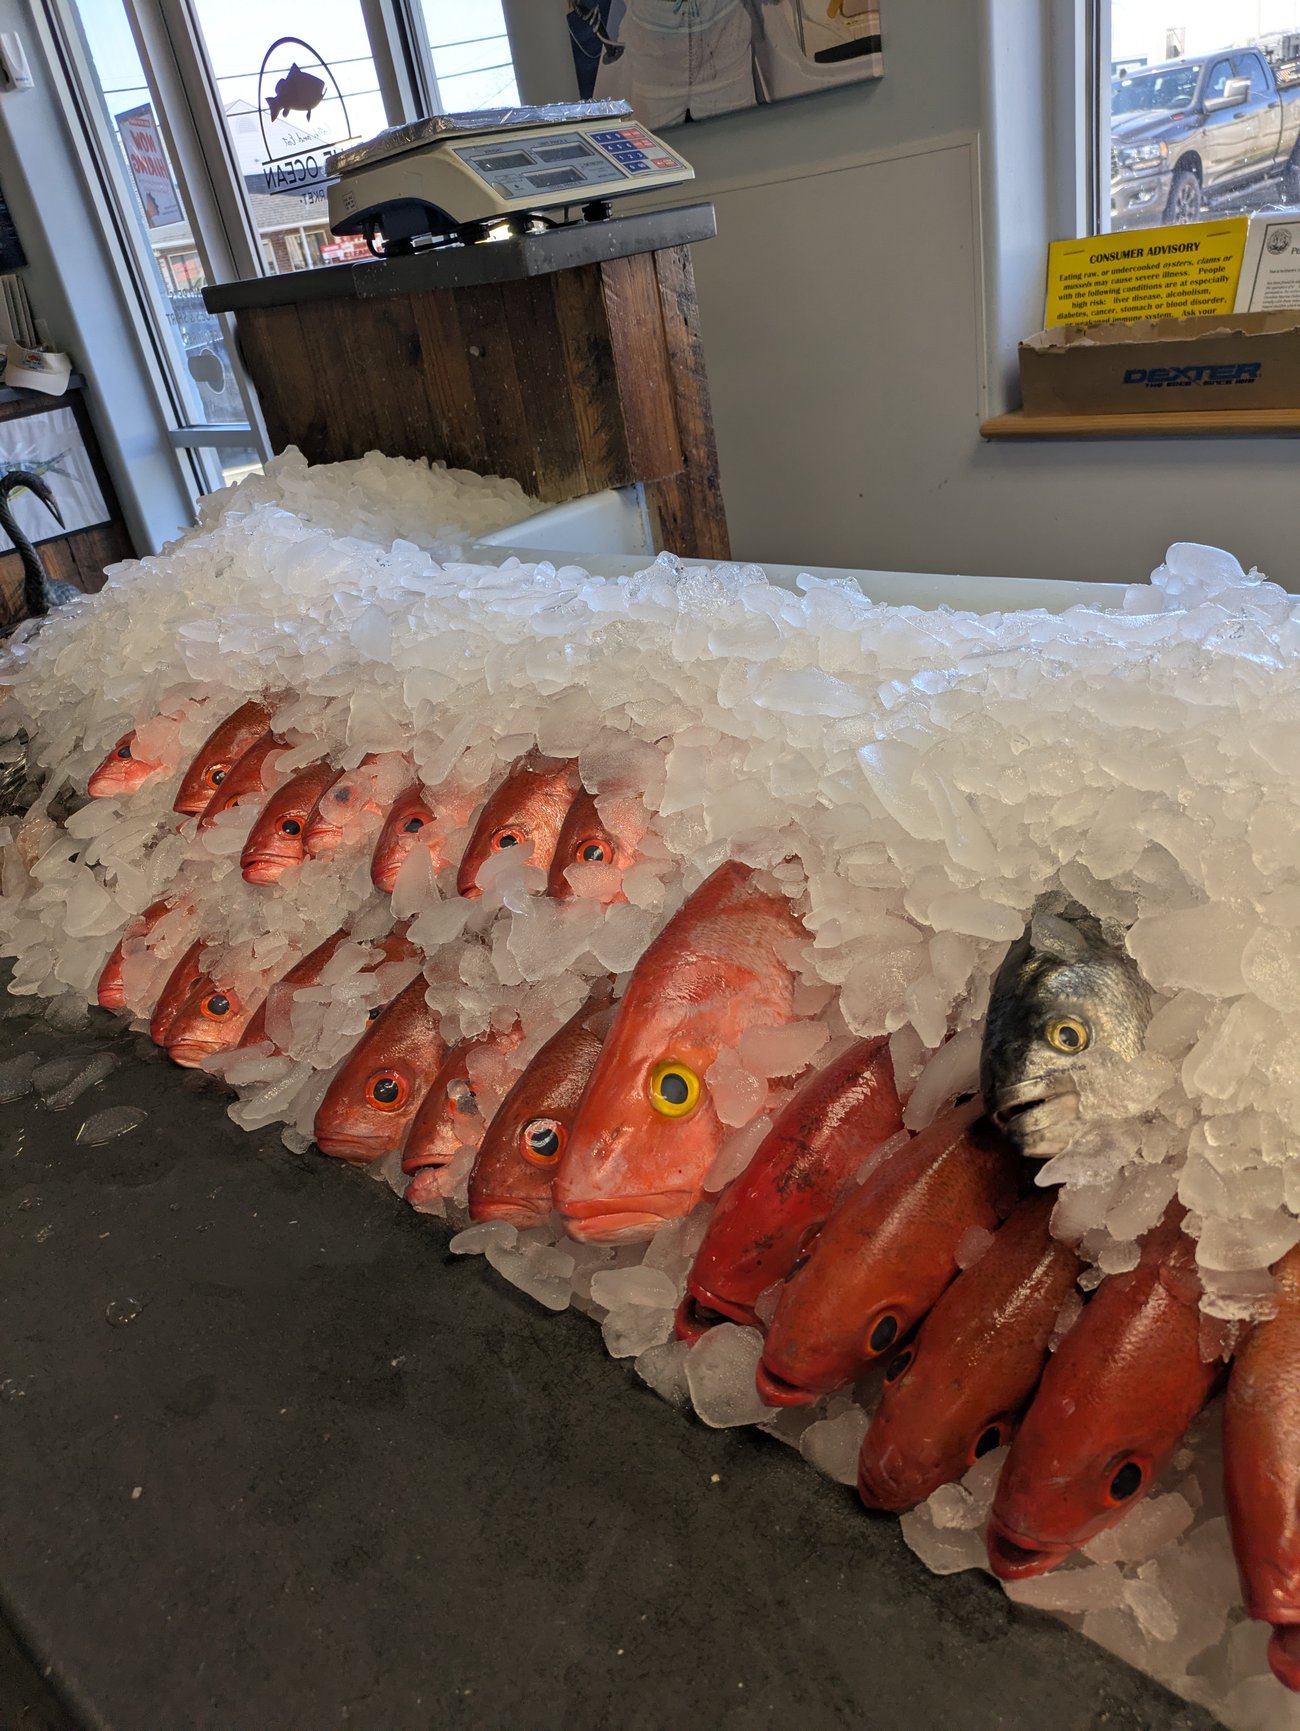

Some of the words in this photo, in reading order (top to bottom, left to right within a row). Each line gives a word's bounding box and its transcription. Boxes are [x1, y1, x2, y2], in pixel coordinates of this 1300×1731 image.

[1090, 248, 1144, 264] CONSUMER
[1146, 242, 1200, 256] ADVISORY
[1060, 273, 1082, 282] Eating
[1111, 263, 1160, 275] undercooked
[1197, 256, 1221, 265] clams
[1063, 282, 1092, 290] mussels
[1111, 277, 1133, 285] cause
[1198, 266, 1226, 275] People
[1058, 292, 1072, 300] with
[1088, 288, 1120, 297] following
[1122, 281, 1162, 293] conditions
[1190, 275, 1229, 286] especially
[1072, 301, 1088, 309] high
[1120, 304, 1152, 312] stomach
[1166, 299, 1188, 308] blood
[1123, 362, 1261, 384] DEXTER
